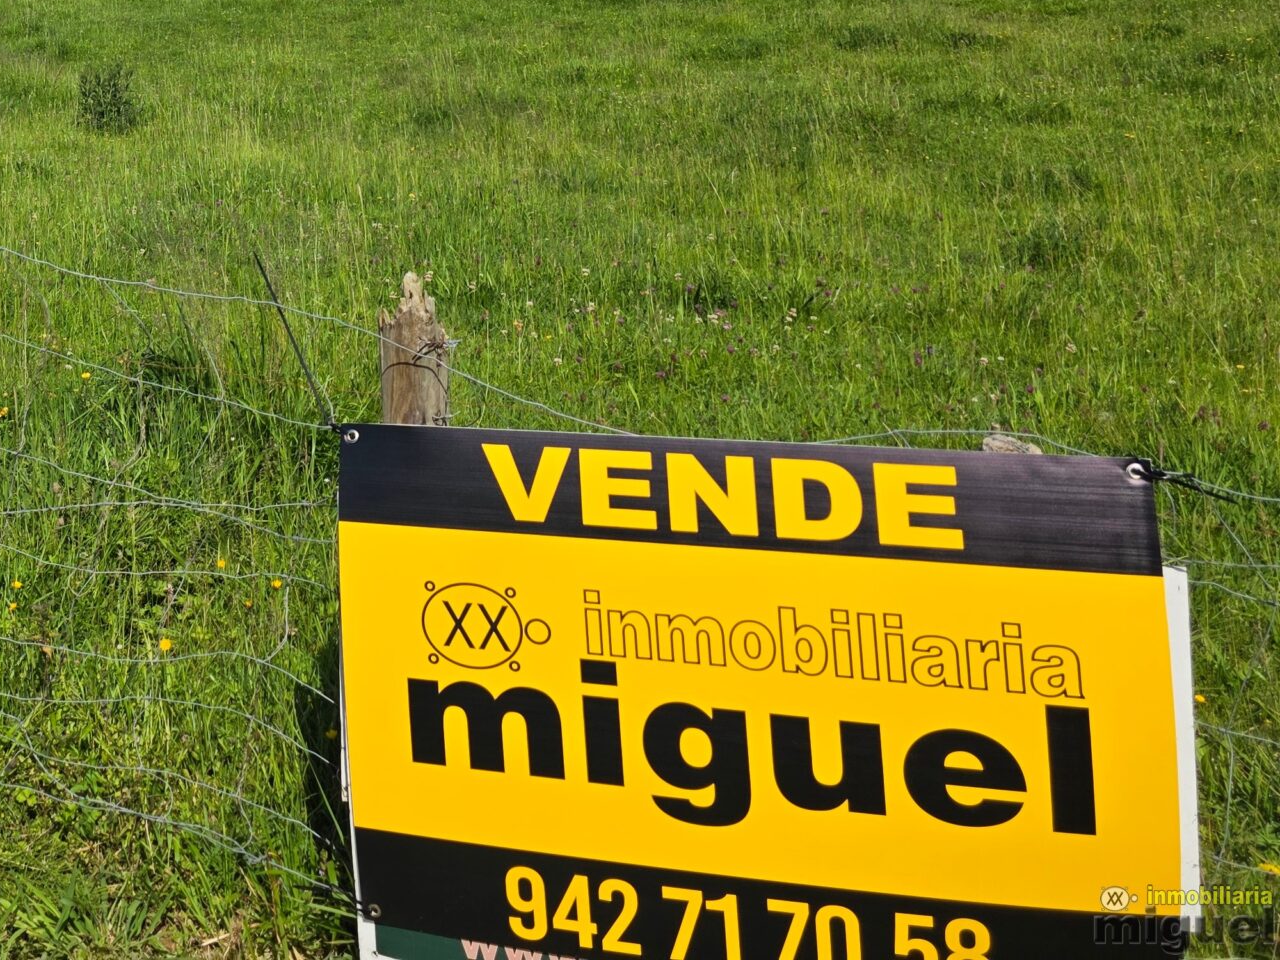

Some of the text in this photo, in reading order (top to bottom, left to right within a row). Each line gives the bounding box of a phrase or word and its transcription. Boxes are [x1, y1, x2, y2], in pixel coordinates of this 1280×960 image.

[482, 443, 965, 551] VENDE
[583, 589, 1085, 700] inmobiliaria
[407, 658, 1097, 836] miguel
[505, 865, 642, 957] 942
[662, 886, 742, 960] 71
[767, 898, 862, 960] 70
